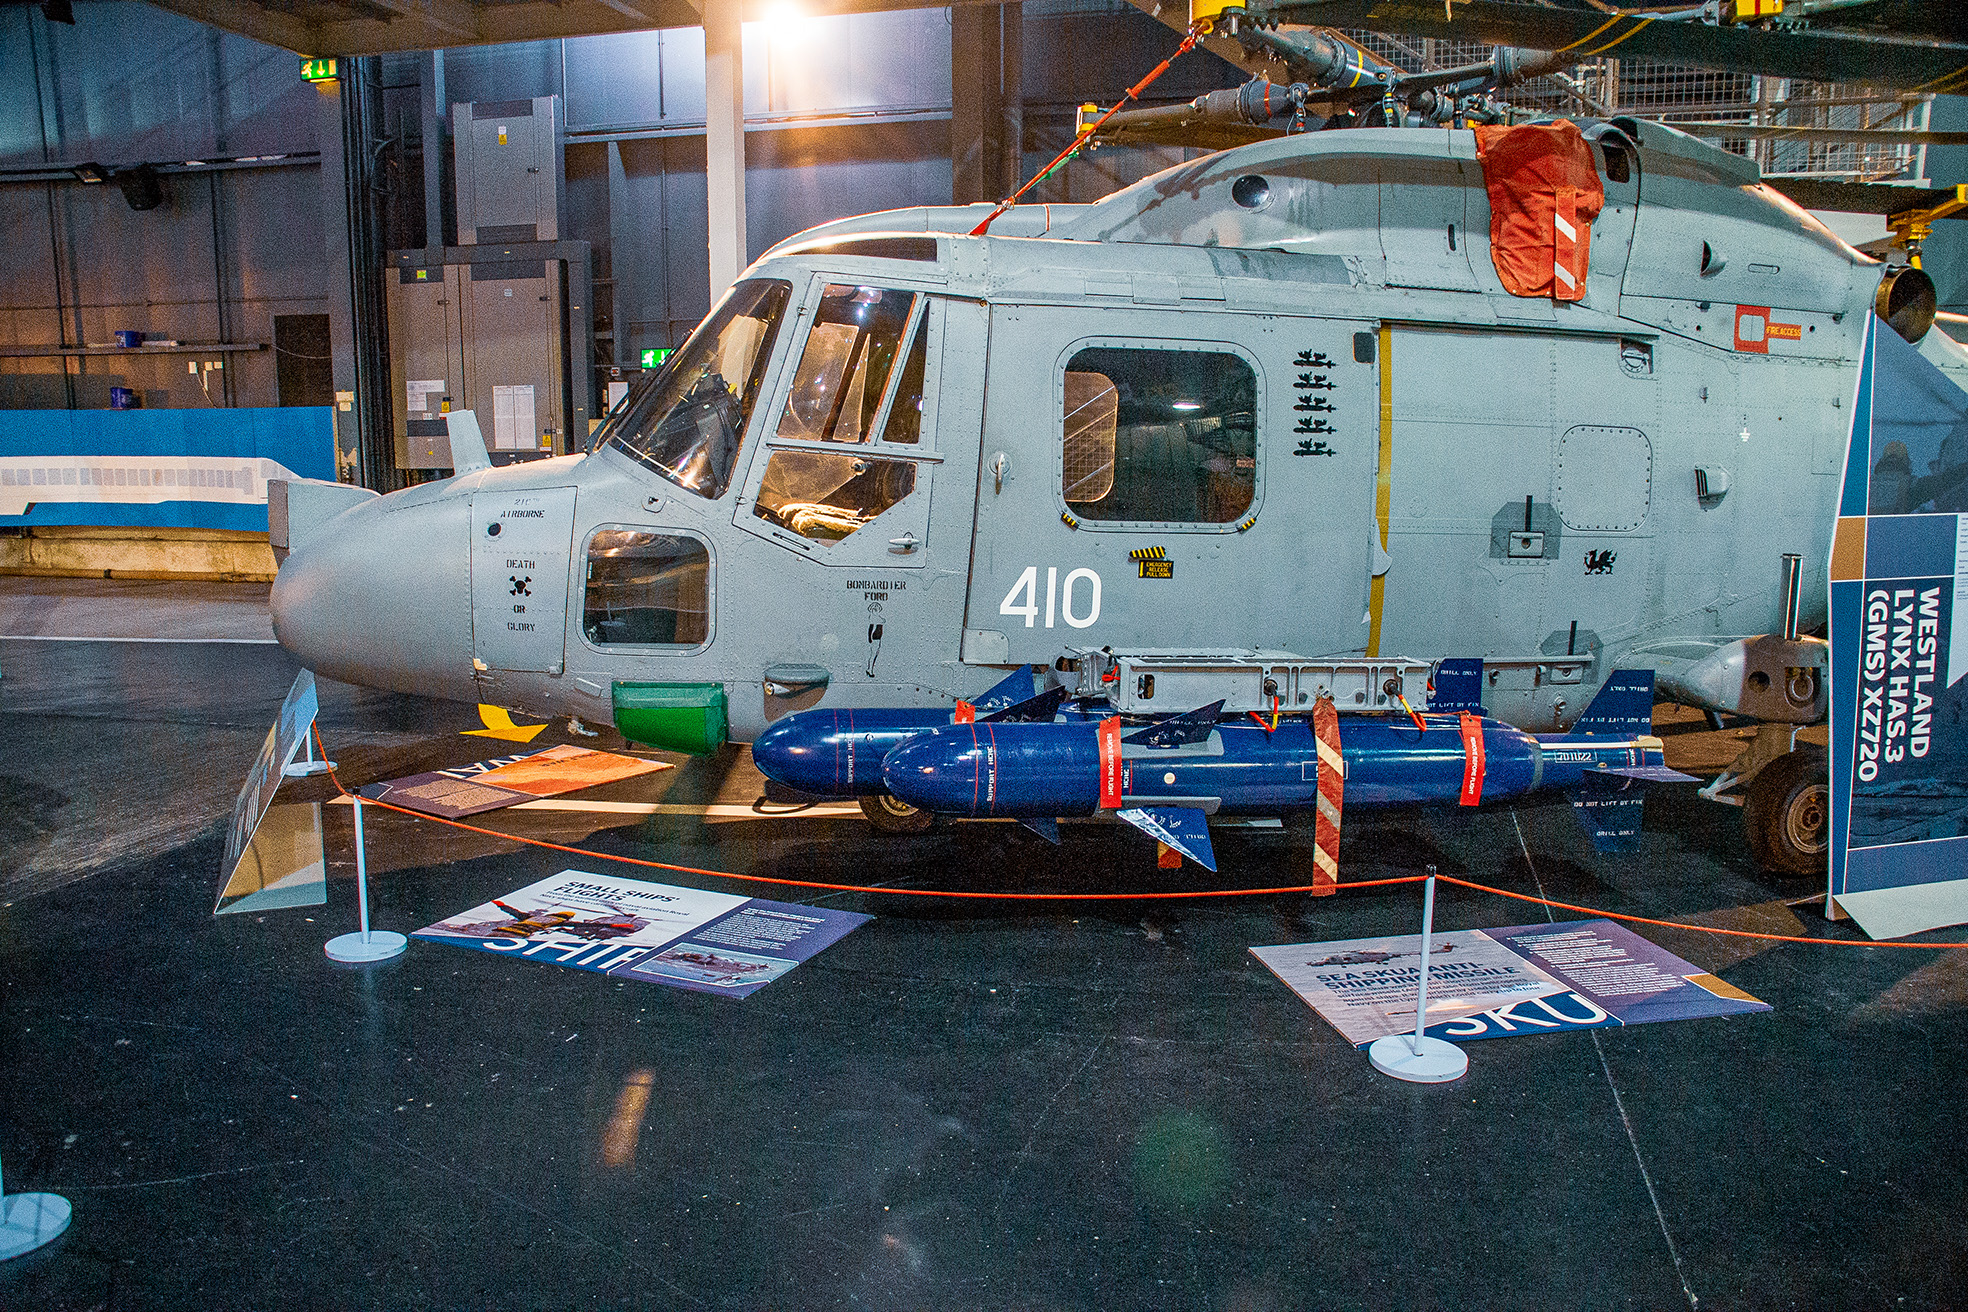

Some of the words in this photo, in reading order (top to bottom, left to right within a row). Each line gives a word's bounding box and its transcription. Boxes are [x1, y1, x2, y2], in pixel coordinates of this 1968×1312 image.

[1766, 326, 1779, 335] FIRE
[1780, 327, 1801, 337] ACCESS
[501, 510, 545, 518] AIRBORNE
[506, 560, 535, 569] DEATH
[864, 592, 888, 601] FORD
[1000, 566, 1102, 628] 410
[513, 605, 526, 613] OR
[507, 622, 536, 631] GLORY
[1864, 589, 1890, 681] (GMS)
[1890, 589, 1915, 670] LYNX
[1910, 586, 1940, 758] WESTLAND
[1884, 675, 1909, 763] HAS.3
[1858, 686, 1884, 782] XZ720
[1107, 755, 1115, 777] BEFORE
[553, 886, 627, 901] FLIGHTS
[564, 881, 621, 894] SMALL
[621, 890, 681, 902] SHIPS'
[1316, 972, 1361, 982] SEA
[1362, 966, 1420, 979] SKUA
[1427, 961, 1484, 973] ANTI-
[1432, 966, 1521, 980] MISSILE
